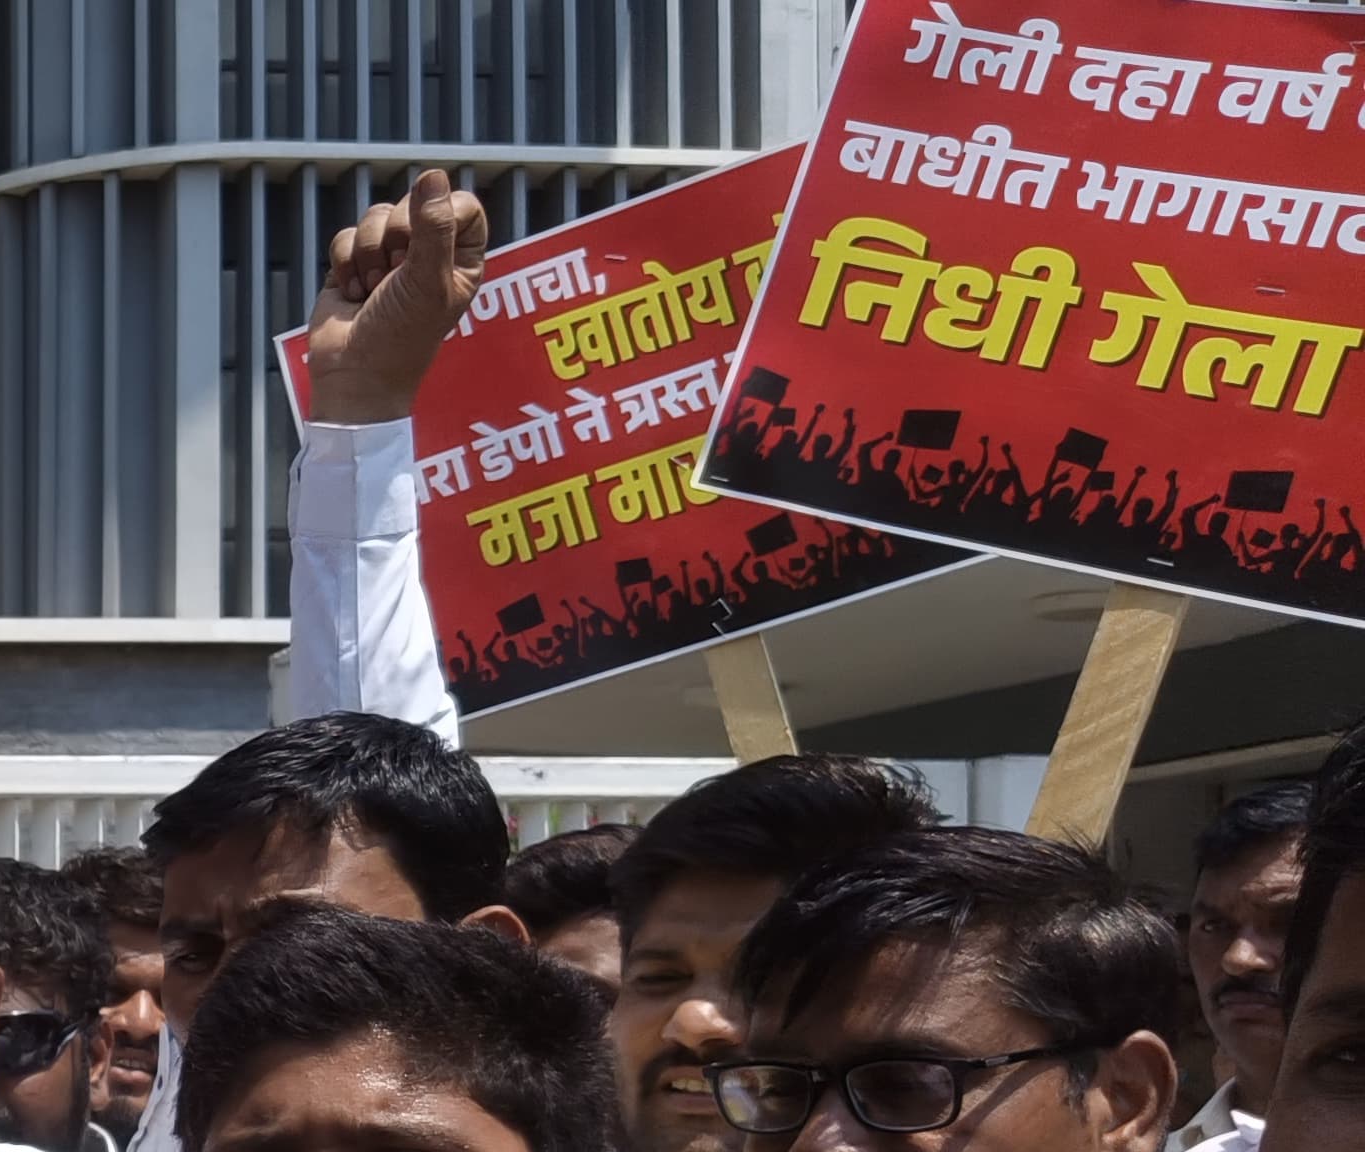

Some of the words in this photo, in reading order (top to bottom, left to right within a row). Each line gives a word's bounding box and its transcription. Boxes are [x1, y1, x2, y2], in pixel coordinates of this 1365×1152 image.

[903, 1, 1064, 96] गेली
[1068, 46, 1214, 121] दहा
[1218, 52, 1356, 131] वर्ष
[838, 119, 1071, 210] बाधीत
[443, 247, 606, 341] णाचा,
[534, 258, 737, 381] खातोय
[799, 217, 1083, 370] निधी
[1090, 262, 1363, 417] गेला
[469, 403, 564, 482] डेपो
[563, 386, 612, 443] ने
[613, 357, 719, 434] त्रस्त
[467, 474, 600, 565] मजा
